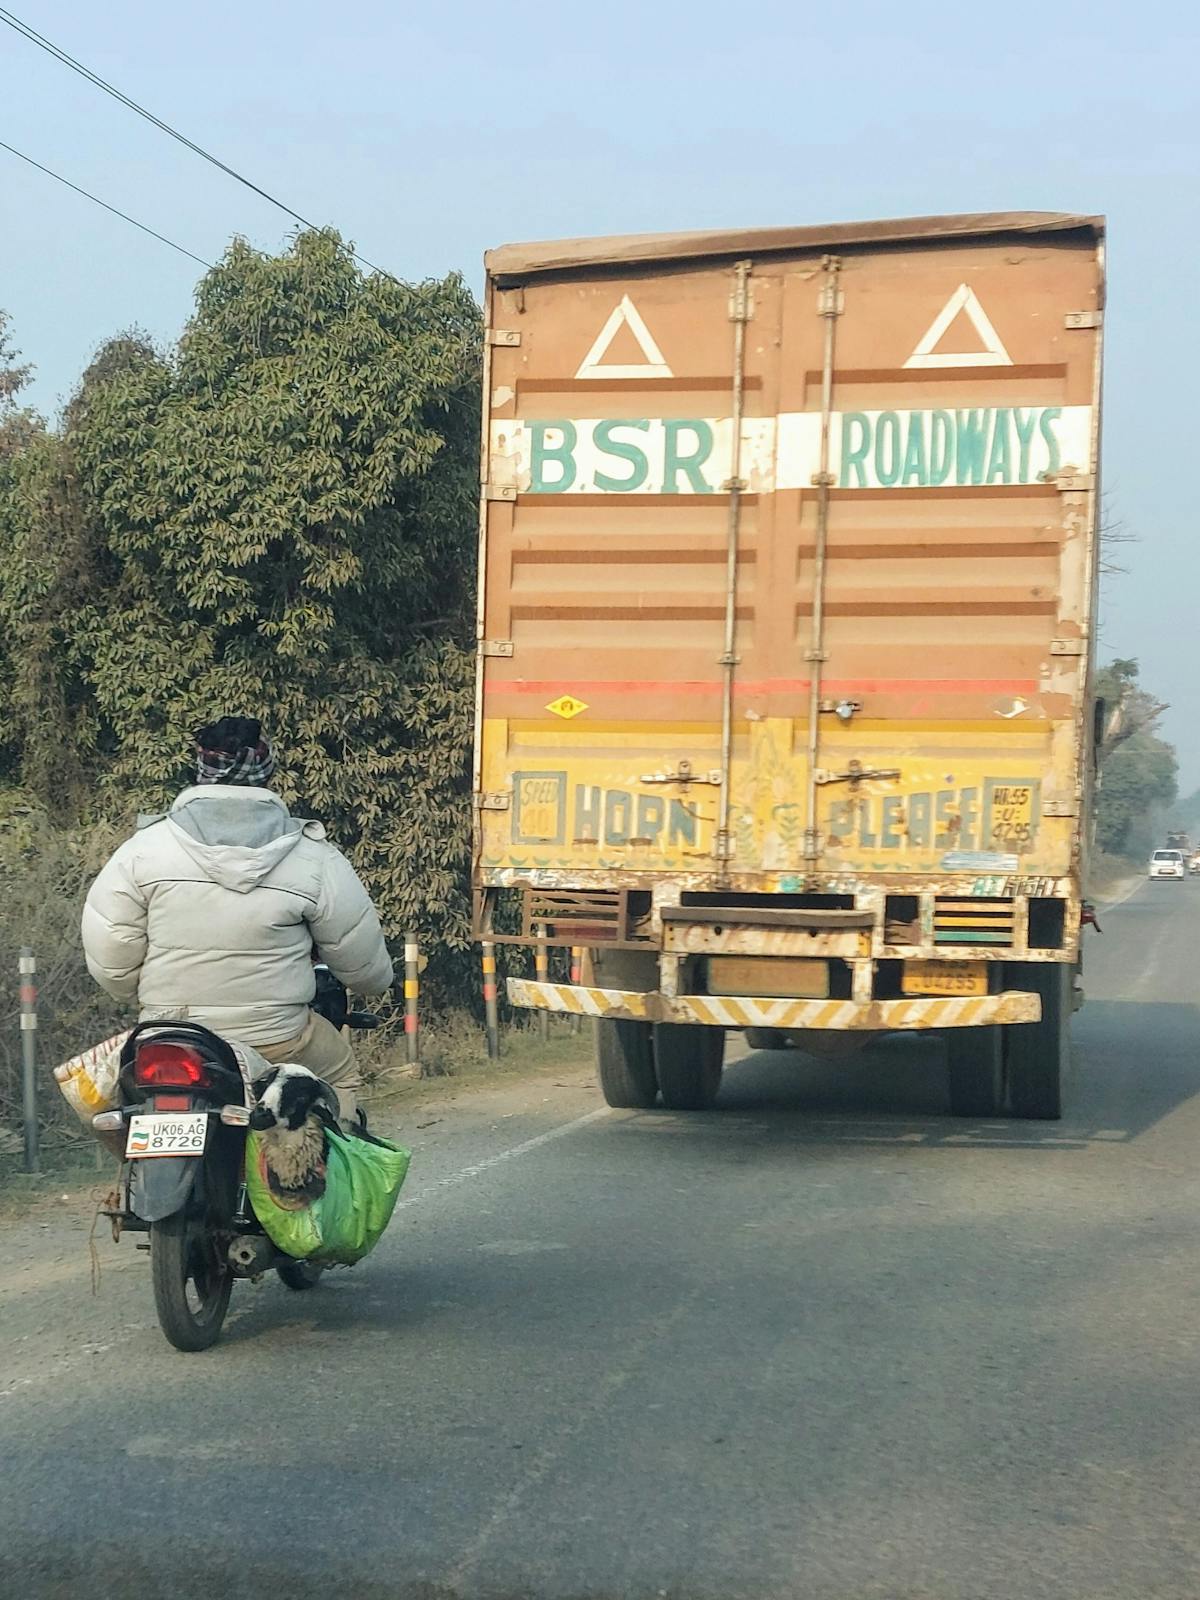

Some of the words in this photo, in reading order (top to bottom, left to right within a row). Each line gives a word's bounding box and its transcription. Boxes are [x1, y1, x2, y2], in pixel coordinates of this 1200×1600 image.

[840, 407, 1062, 487] ROADWAYS
[574, 784, 698, 847] HORN
[829, 787, 977, 850] PLEASE
[152, 1136, 203, 1148] 8726
